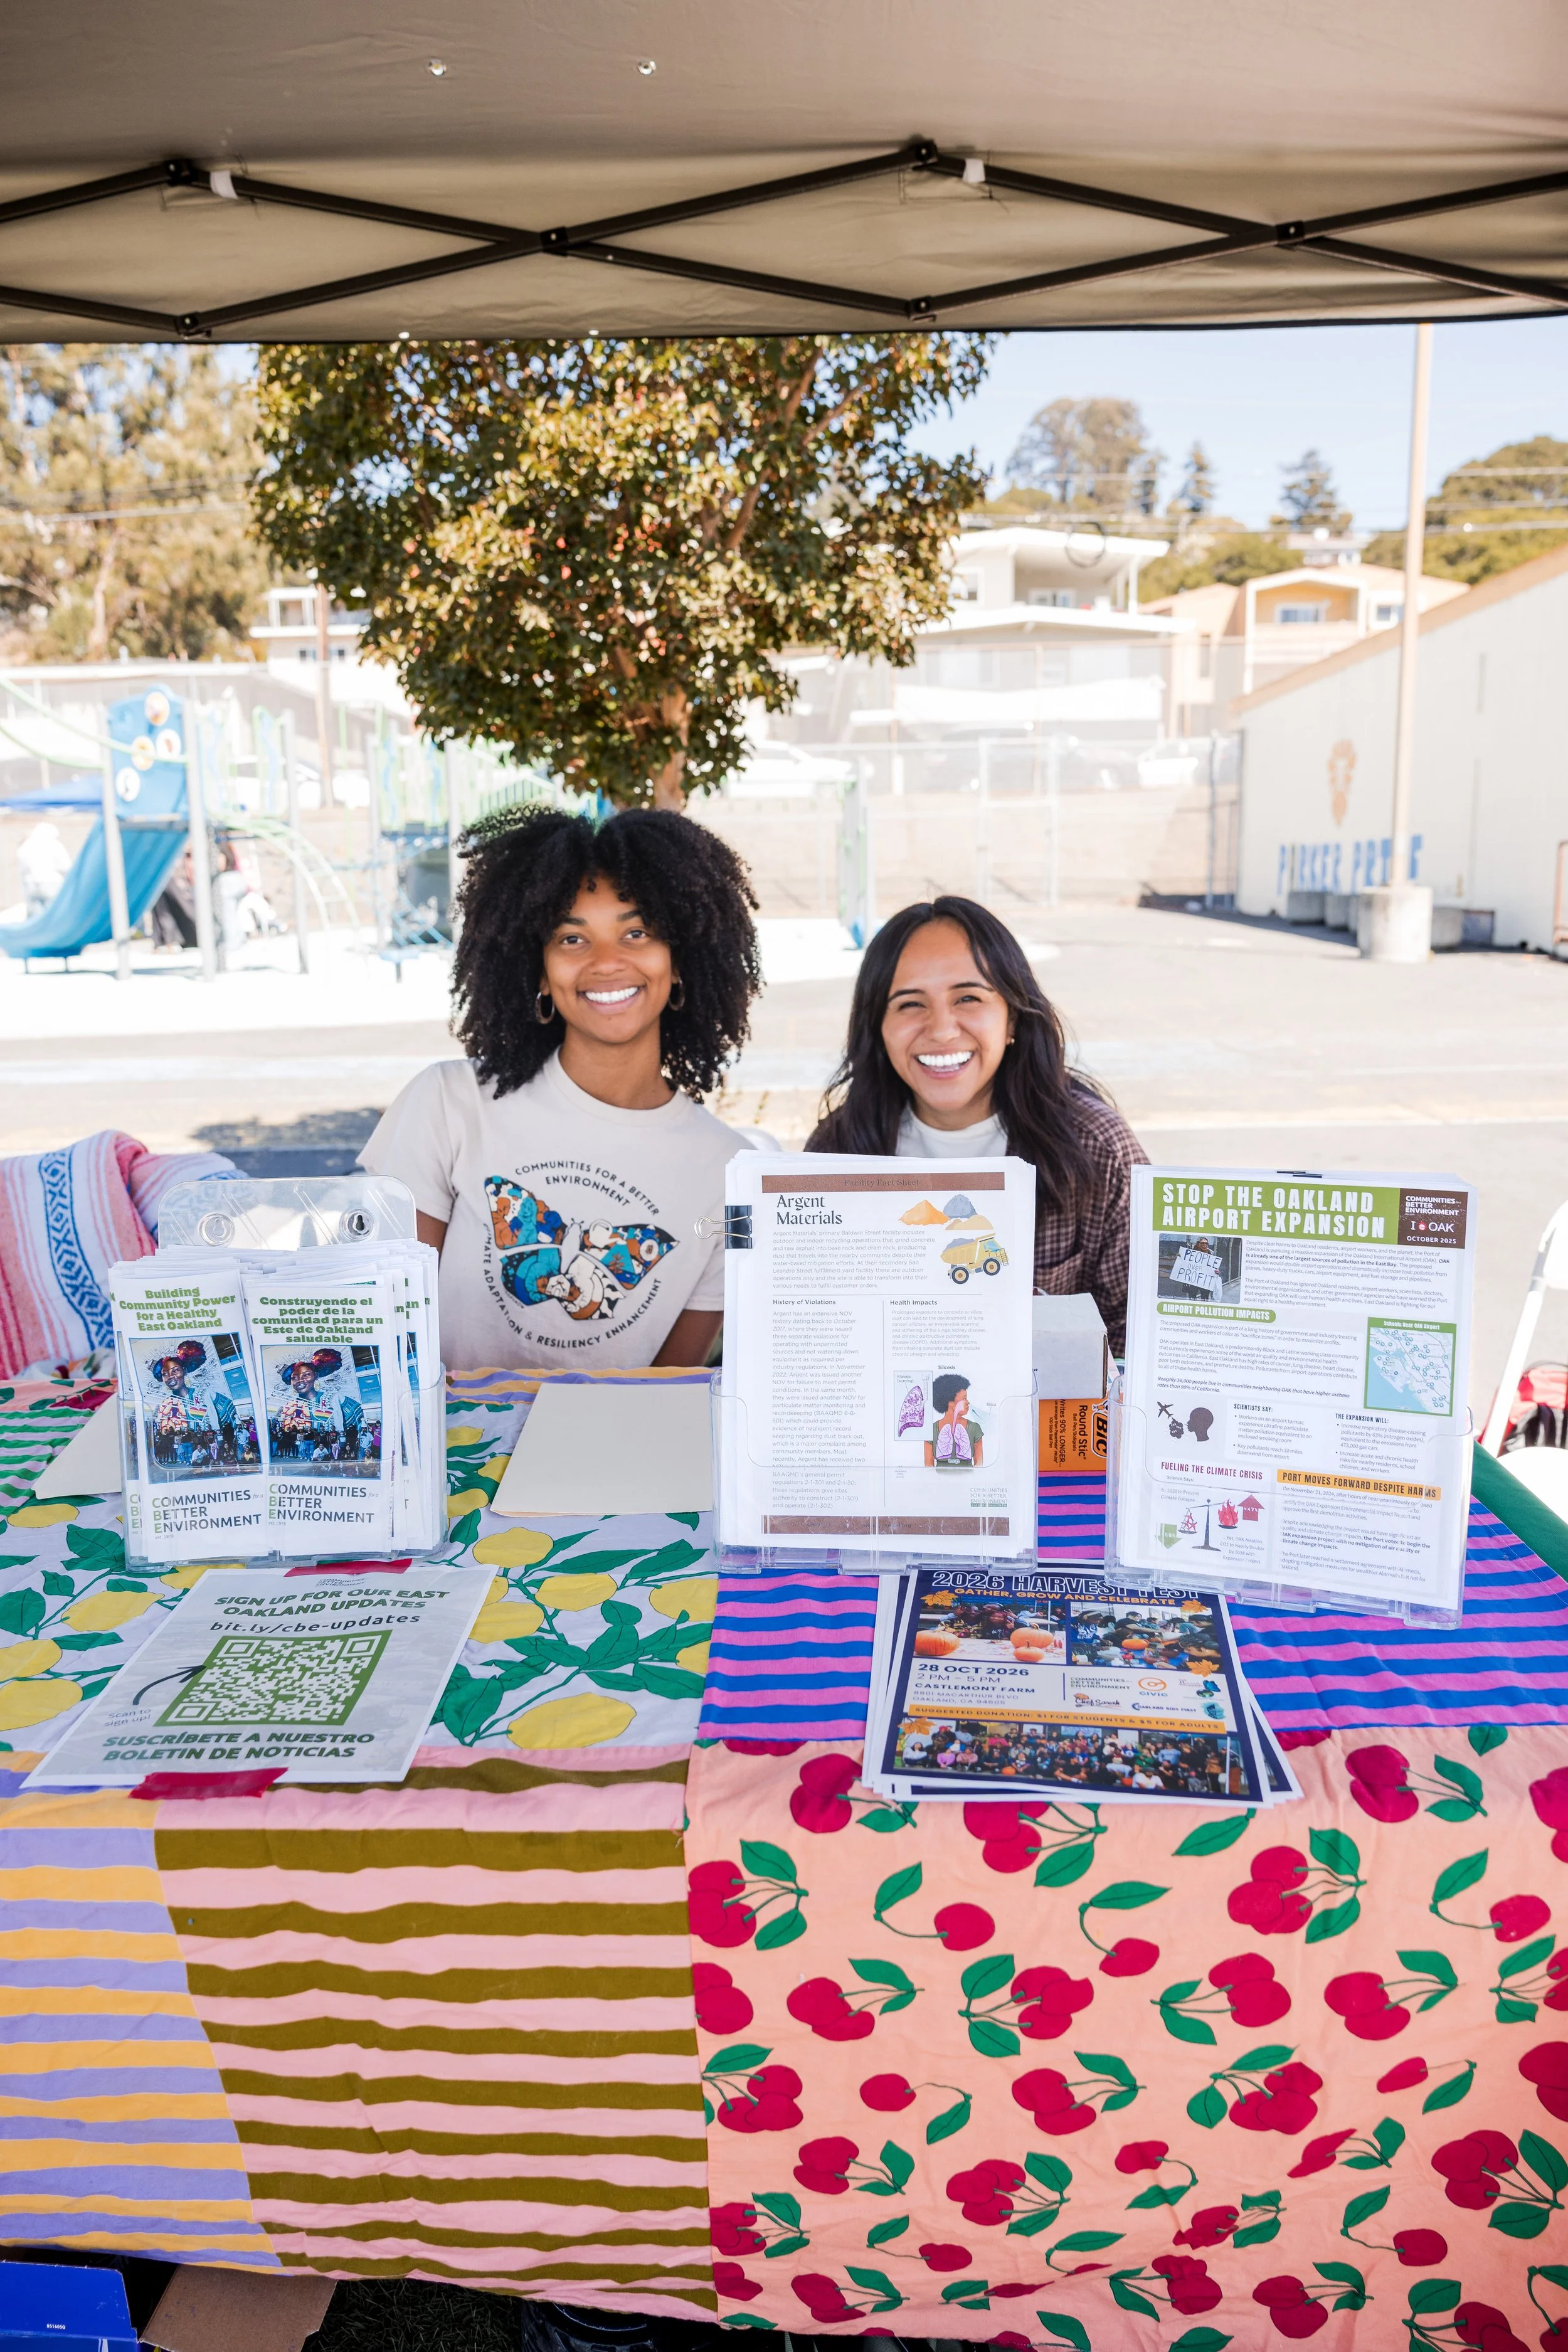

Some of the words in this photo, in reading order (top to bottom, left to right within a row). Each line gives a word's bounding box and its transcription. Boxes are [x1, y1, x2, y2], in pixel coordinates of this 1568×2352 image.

[515, 1160, 591, 1176] COMMUNITIES
[595, 1167, 618, 1182] FOR
[628, 1185, 660, 1216] BETTER
[844, 1179, 875, 1187] Facility
[546, 1175, 630, 1207] ENVIRONMENT
[1162, 1183, 1214, 1205] STOP
[1225, 1185, 1263, 1208] THE
[1273, 1188, 1374, 1214] OAKLAND
[776, 1194, 825, 1211] Argent
[1406, 1195, 1456, 1204] COMMUNITIES
[776, 1210, 843, 1225] Materials
[1405, 1207, 1459, 1216] ENVIRONMENT
[1162, 1205, 1251, 1230] AIRPORT
[1261, 1210, 1385, 1238] EXPANSION
[1411, 1221, 1416, 1230] I
[1428, 1222, 1454, 1232] OAK
[1184, 1249, 1221, 1269] PEOPLE
[1187, 1263, 1202, 1271] OVER
[1177, 1268, 1215, 1288] PROFIT
[145, 1287, 200, 1299] Building
[119, 1300, 190, 1310] Community
[193, 1295, 236, 1306] Power
[260, 1297, 358, 1306] Construyendo
[484, 1269, 523, 1335] ADAPTATION
[524, 1331, 532, 1340] &
[537, 1335, 601, 1349] RESILIENCY
[605, 1278, 662, 1339] ENHANCEMENT
[136, 1311, 154, 1320] for
[166, 1308, 217, 1319] Healthy
[279, 1308, 320, 1316] poder
[1163, 1303, 1193, 1315] AIRPORT
[1195, 1306, 1234, 1318] POLLUTION
[1236, 1310, 1270, 1320] IMPACTS
[137, 1321, 166, 1331] East
[167, 1318, 223, 1330] Oakland
[263, 1326, 294, 1334] Este
[296, 1326, 314, 1334] de
[316, 1326, 373, 1334] Oakland
[286, 1335, 353, 1343] saludable
[1234, 1404, 1261, 1412] SCIENTISTS
[1079, 1405, 1088, 1436] Round
[1346, 1414, 1374, 1422] EXPANSION
[1161, 1461, 1189, 1472] FUELING
[1192, 1465, 1204, 1473] THE
[1206, 1466, 1237, 1477] CLIMATE
[1239, 1470, 1263, 1480] CRISIS
[269, 1483, 367, 1497] COMMUNITIES
[1283, 1472, 1301, 1482] PORT
[1305, 1474, 1331, 1485] MOVES
[1333, 1477, 1370, 1490] FORWARD
[1374, 1481, 1404, 1494] DESPITE
[152, 1490, 251, 1508] COMMUNITIES
[269, 1496, 322, 1508] BETTER
[153, 1506, 208, 1521] BETTER
[268, 1509, 374, 1523] ENVIRONMENT
[154, 1513, 262, 1534] ENVIRONMENT
[932, 1571, 1004, 1591] 2026
[213, 1596, 265, 1606] SIGN
[269, 1594, 298, 1606] UP
[300, 1590, 343, 1602] FOR
[347, 1588, 392, 1597] OUR
[396, 1590, 451, 1599] EAST
[954, 1587, 1012, 1598] GATHER,
[1098, 1596, 1175, 1606] CELEBRATE
[223, 1603, 326, 1618] OAKLAND
[330, 1599, 427, 1611] UPDATES
[209, 1614, 421, 1634] bit.ly/cbe-updates
[918, 1663, 940, 1672] 28
[944, 1666, 982, 1674] OCT
[986, 1667, 1029, 1676] 2026
[915, 1683, 997, 1692] CASTLEMONT
[104, 1719, 129, 1727] sign
[131, 1714, 151, 1724] up!
[108, 1710, 137, 1719] Scan
[102, 1731, 243, 1747] SUSCRÍBETE
[243, 1733, 261, 1742] A
[266, 1733, 375, 1744] NUESTRO
[102, 1747, 205, 1761] BOLETIN
[208, 1747, 241, 1759] DE
[243, 1746, 356, 1759] NOTICIAS
